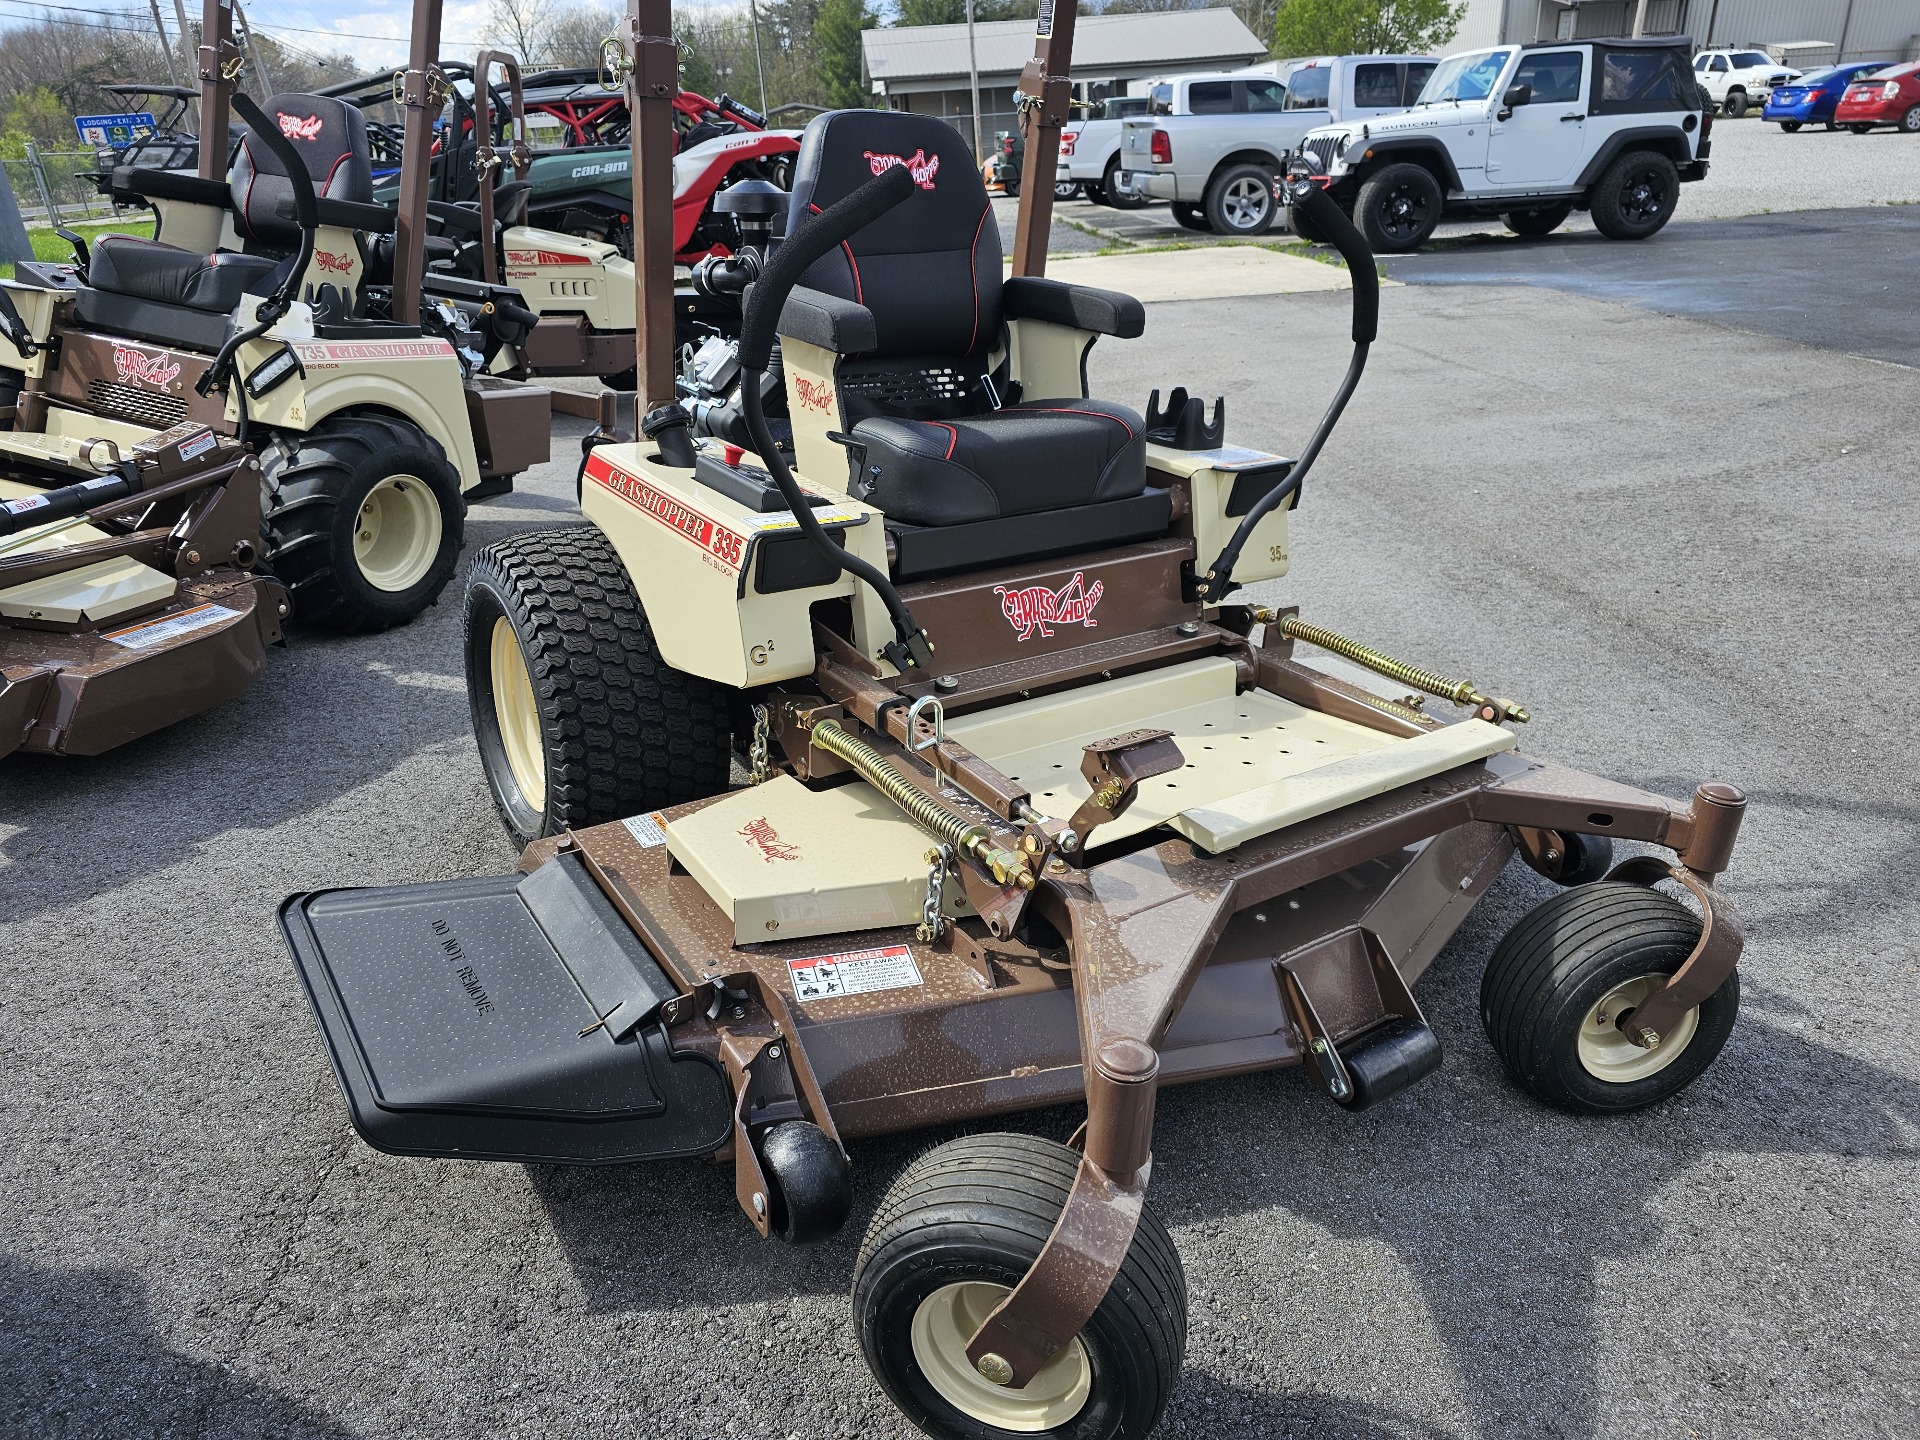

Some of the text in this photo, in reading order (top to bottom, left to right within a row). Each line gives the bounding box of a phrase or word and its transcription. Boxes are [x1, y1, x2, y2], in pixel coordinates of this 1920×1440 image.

[1381, 120, 1438, 131] RUBICON
[571, 161, 628, 178] can-am
[296, 344, 443, 360] 735 GRASSHOPPER
[15, 499, 37, 511] STEP
[607, 469, 743, 565] GRASSHOPPER 335
[702, 553, 735, 580] BIG BLOCK
[832, 950, 884, 964] DANGER
[430, 919, 495, 1017] DO NOT REMOVE
